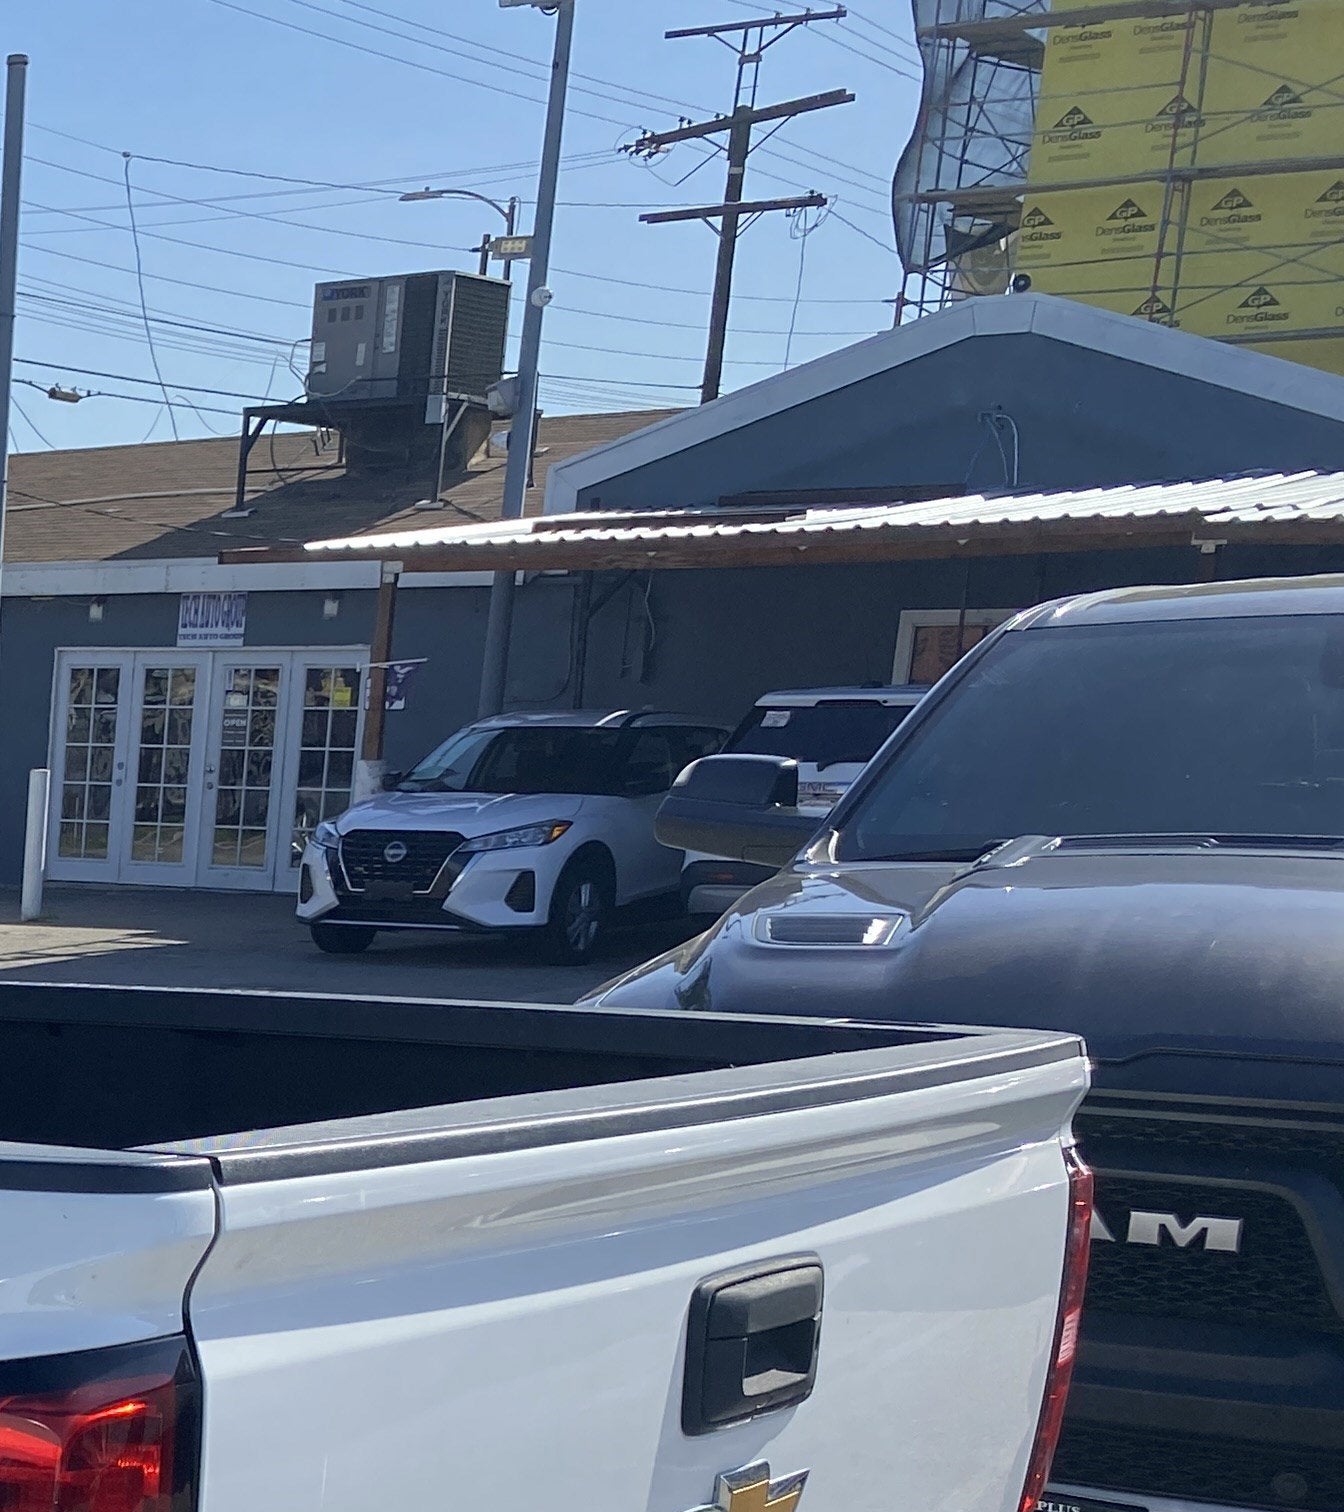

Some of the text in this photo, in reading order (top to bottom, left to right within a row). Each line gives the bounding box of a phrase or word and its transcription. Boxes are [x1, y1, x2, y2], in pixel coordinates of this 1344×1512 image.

[1052, 29, 1112, 46] DensGlass
[1062, 113, 1084, 127] GP
[1042, 128, 1102, 145] DensGlass
[1220, 195, 1244, 209] GP
[1116, 206, 1139, 219] GP
[1023, 215, 1046, 227] GP
[1200, 213, 1262, 227] DensGlass
[1095, 222, 1155, 237] DensGlass
[1247, 294, 1272, 306] GP
[1226, 311, 1290, 324] DensGlass
[223, 718, 247, 727] OPEN
